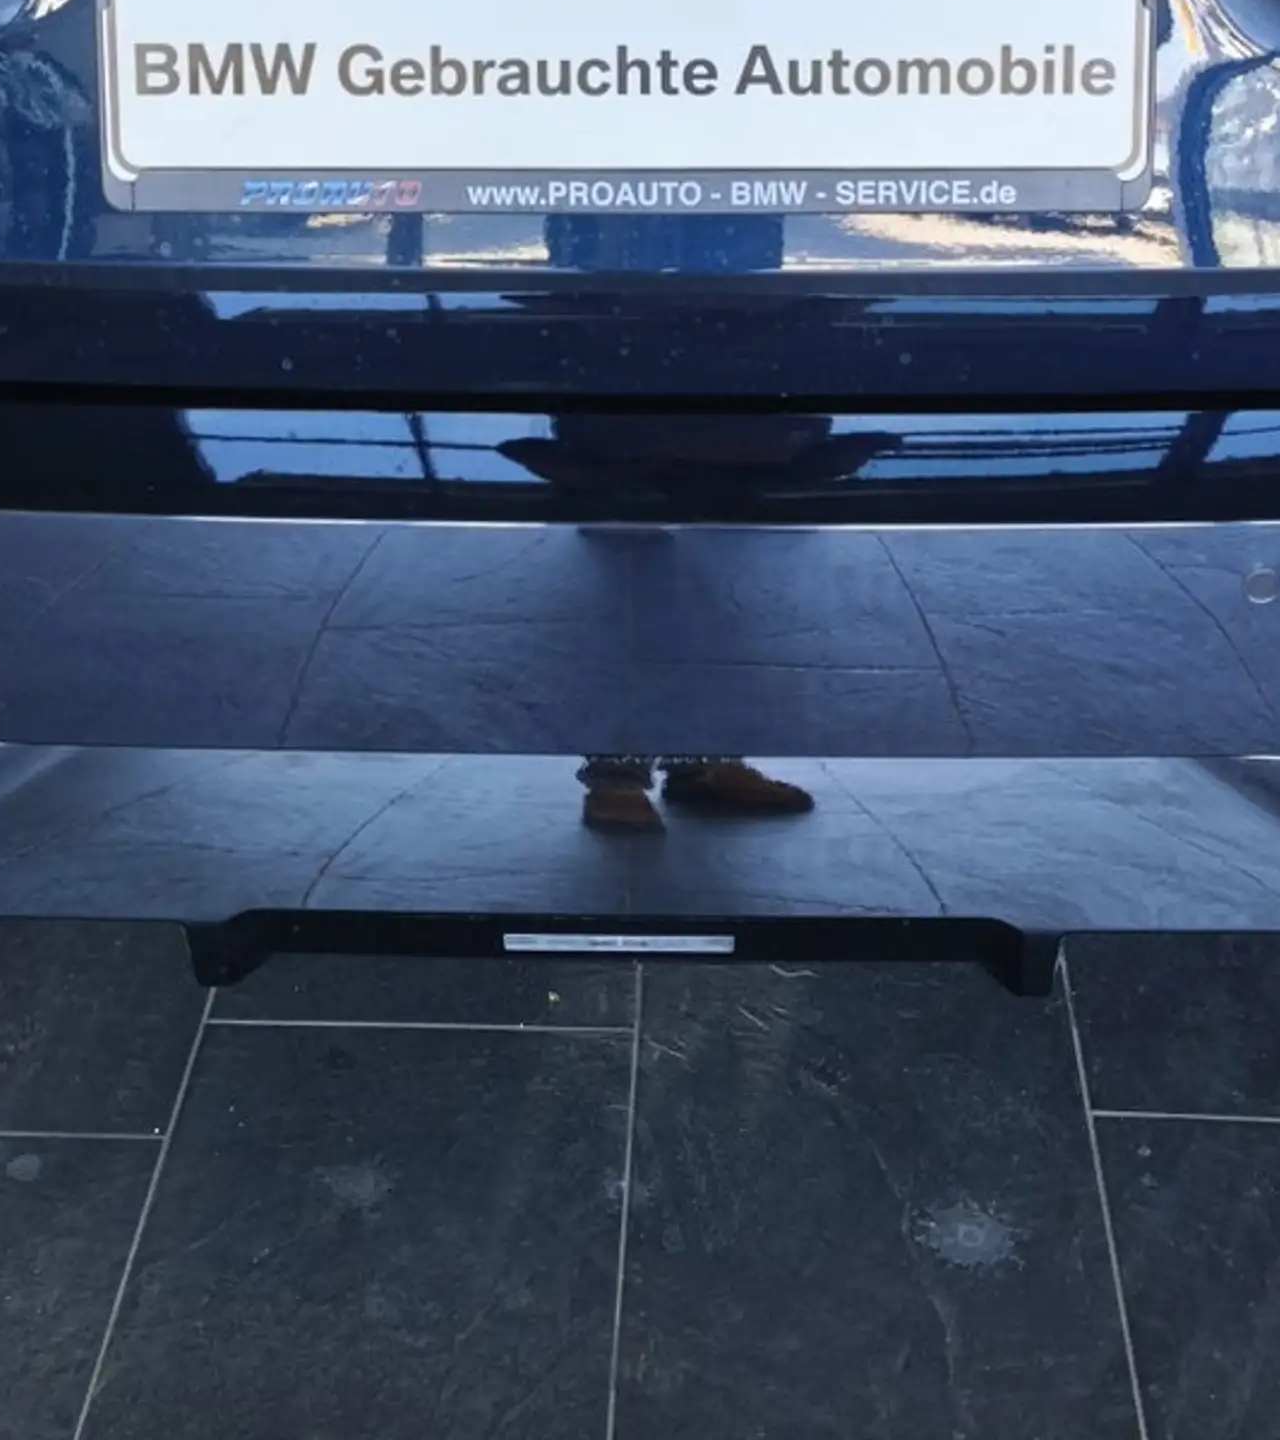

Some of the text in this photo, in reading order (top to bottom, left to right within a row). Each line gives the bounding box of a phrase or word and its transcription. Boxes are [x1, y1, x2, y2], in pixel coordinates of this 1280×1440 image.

[135, 42, 1116, 97] BMW Gebrauchte Automobile
[466, 181, 702, 206] www.PROAUTO
[730, 181, 808, 206] BMW
[835, 180, 1017, 206] SERVICE.de
